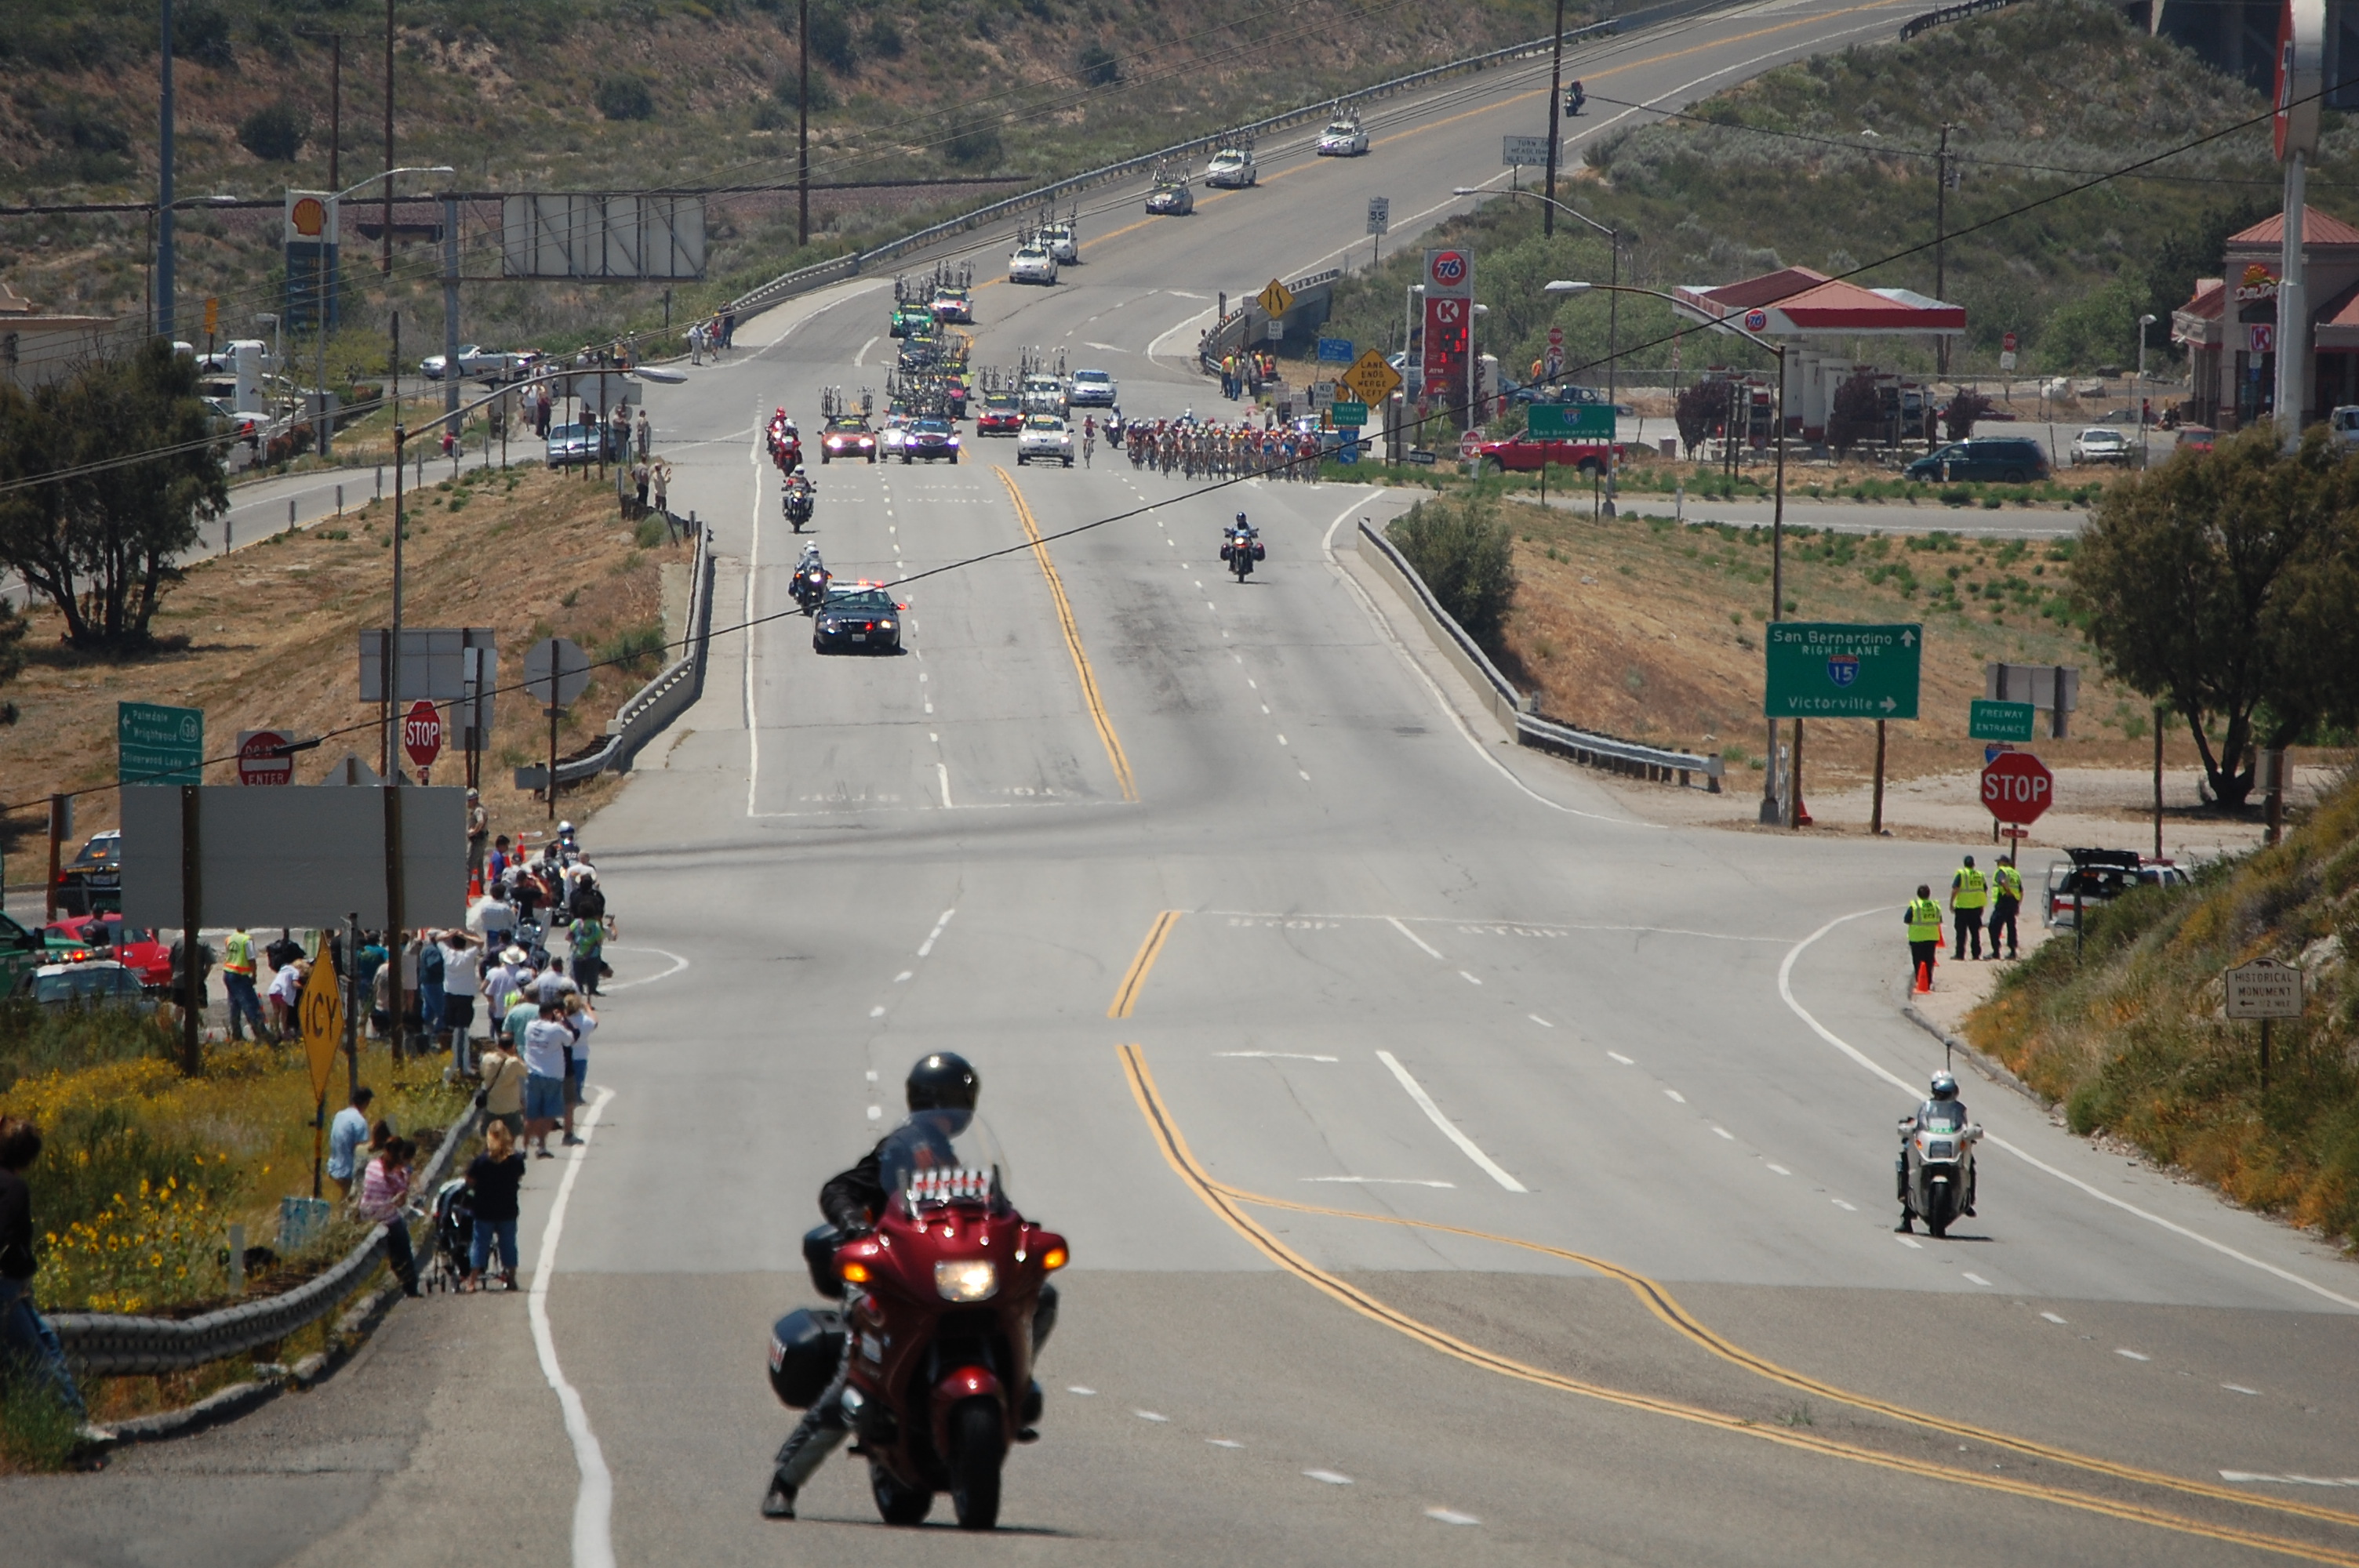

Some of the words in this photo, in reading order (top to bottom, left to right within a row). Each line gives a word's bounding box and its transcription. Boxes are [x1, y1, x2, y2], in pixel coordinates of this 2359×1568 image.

[1438, 259, 1461, 278] 76
[1438, 300, 1459, 322] K
[1747, 313, 1766, 328] 76
[2254, 328, 2270, 350] K
[1568, 413, 1578, 422] 15
[1774, 630, 1802, 643] San
[1808, 630, 1892, 645] Bernardino
[1801, 645, 1840, 655] RIGHT
[1848, 645, 1881, 655] LANE
[1834, 666, 1853, 681] 15
[1788, 696, 1873, 710] Victorville
[133, 710, 168, 723] Palmdale
[1980, 708, 2023, 719] FREEWAY
[133, 727, 177, 742] Wrightwood
[181, 724, 196, 739] 138
[405, 721, 439, 747] STOP
[1976, 723, 2026, 734] ENTRANCE
[122, 752, 162, 765] Silverwood
[165, 755, 182, 768] Lake
[248, 773, 284, 786] ENTER
[1985, 774, 2048, 802] STOP
[2234, 972, 2292, 982] HISTORICAL
[2238, 987, 2291, 996] MONUMENT
[305, 990, 338, 1042] ICY
